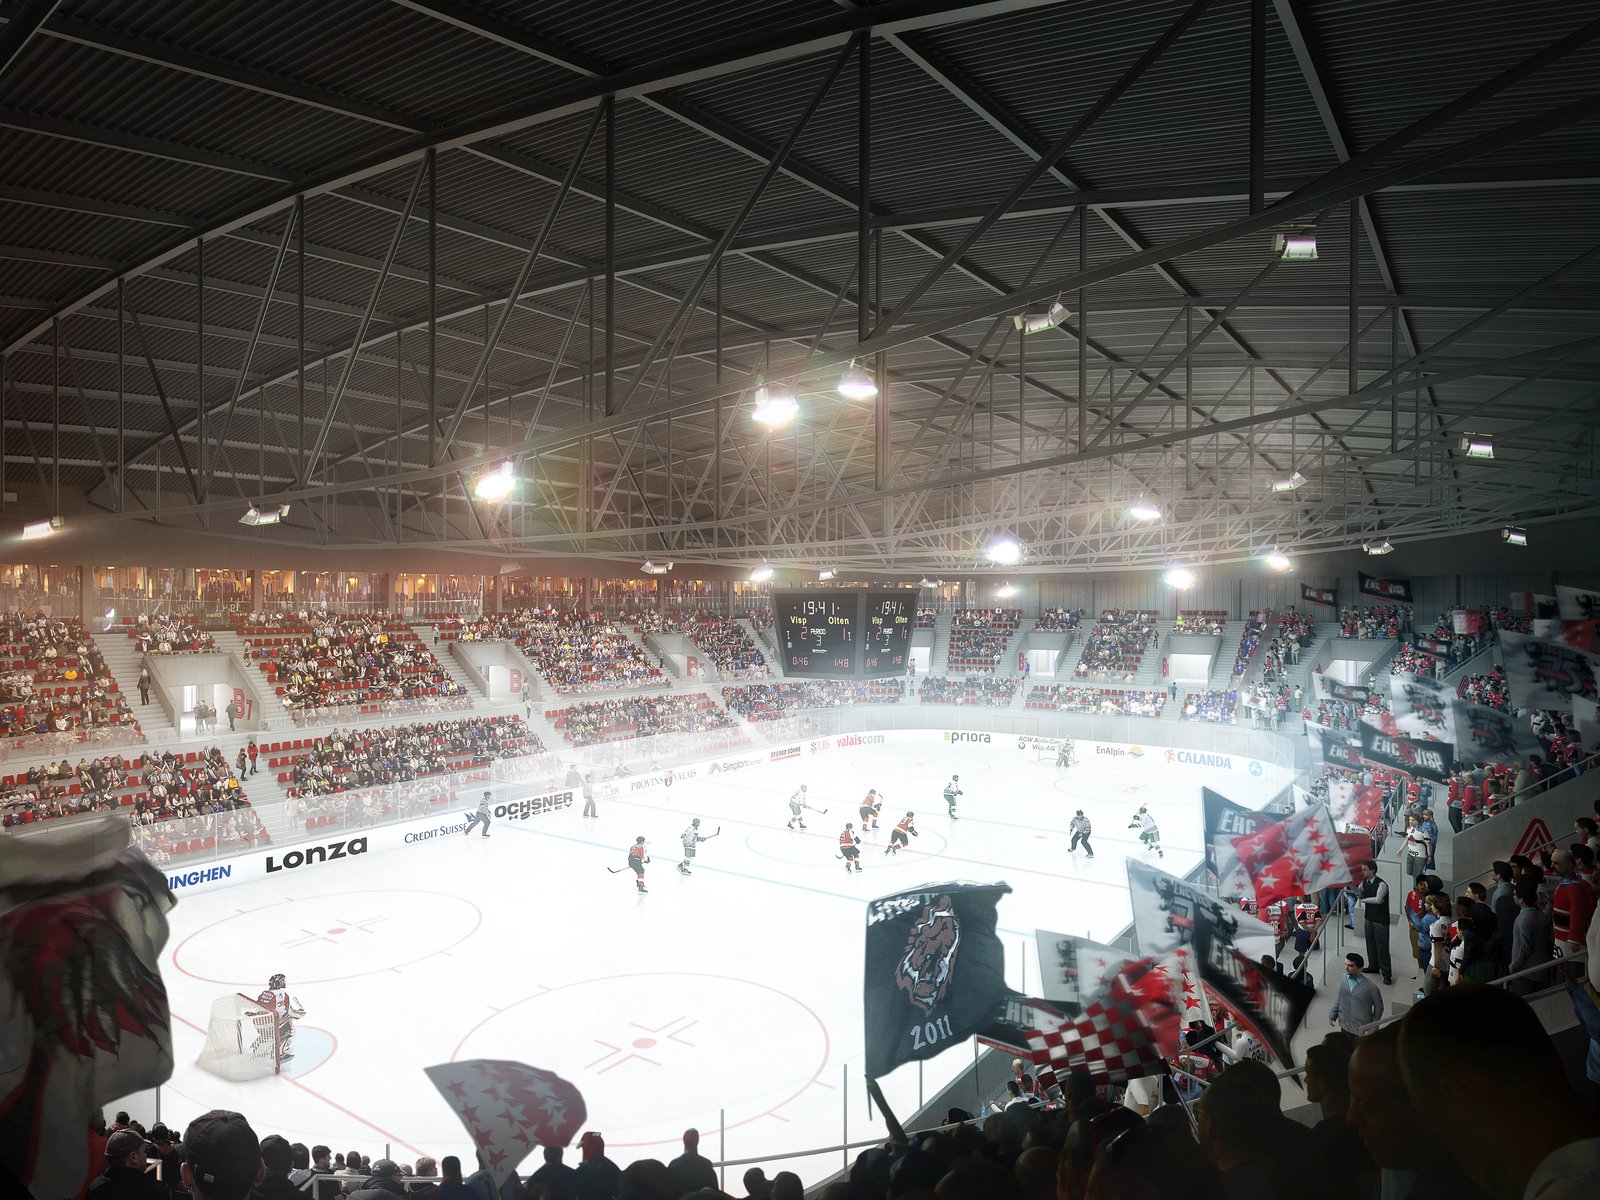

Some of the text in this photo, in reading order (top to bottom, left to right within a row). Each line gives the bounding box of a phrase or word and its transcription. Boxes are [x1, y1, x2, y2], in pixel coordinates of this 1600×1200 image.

[790, 616, 850, 626] Visp Olten
[951, 731, 991, 744] priora
[1371, 736, 1400, 757] EHC
[1096, 745, 1125, 757] EnAlpin
[1177, 751, 1232, 770] CALANDA
[494, 791, 573, 819] OCHSNER
[1217, 808, 1257, 834] EHC
[404, 828, 439, 844] CREDIT
[168, 864, 232, 890] INGHEN
[910, 1014, 953, 1051] 2011
